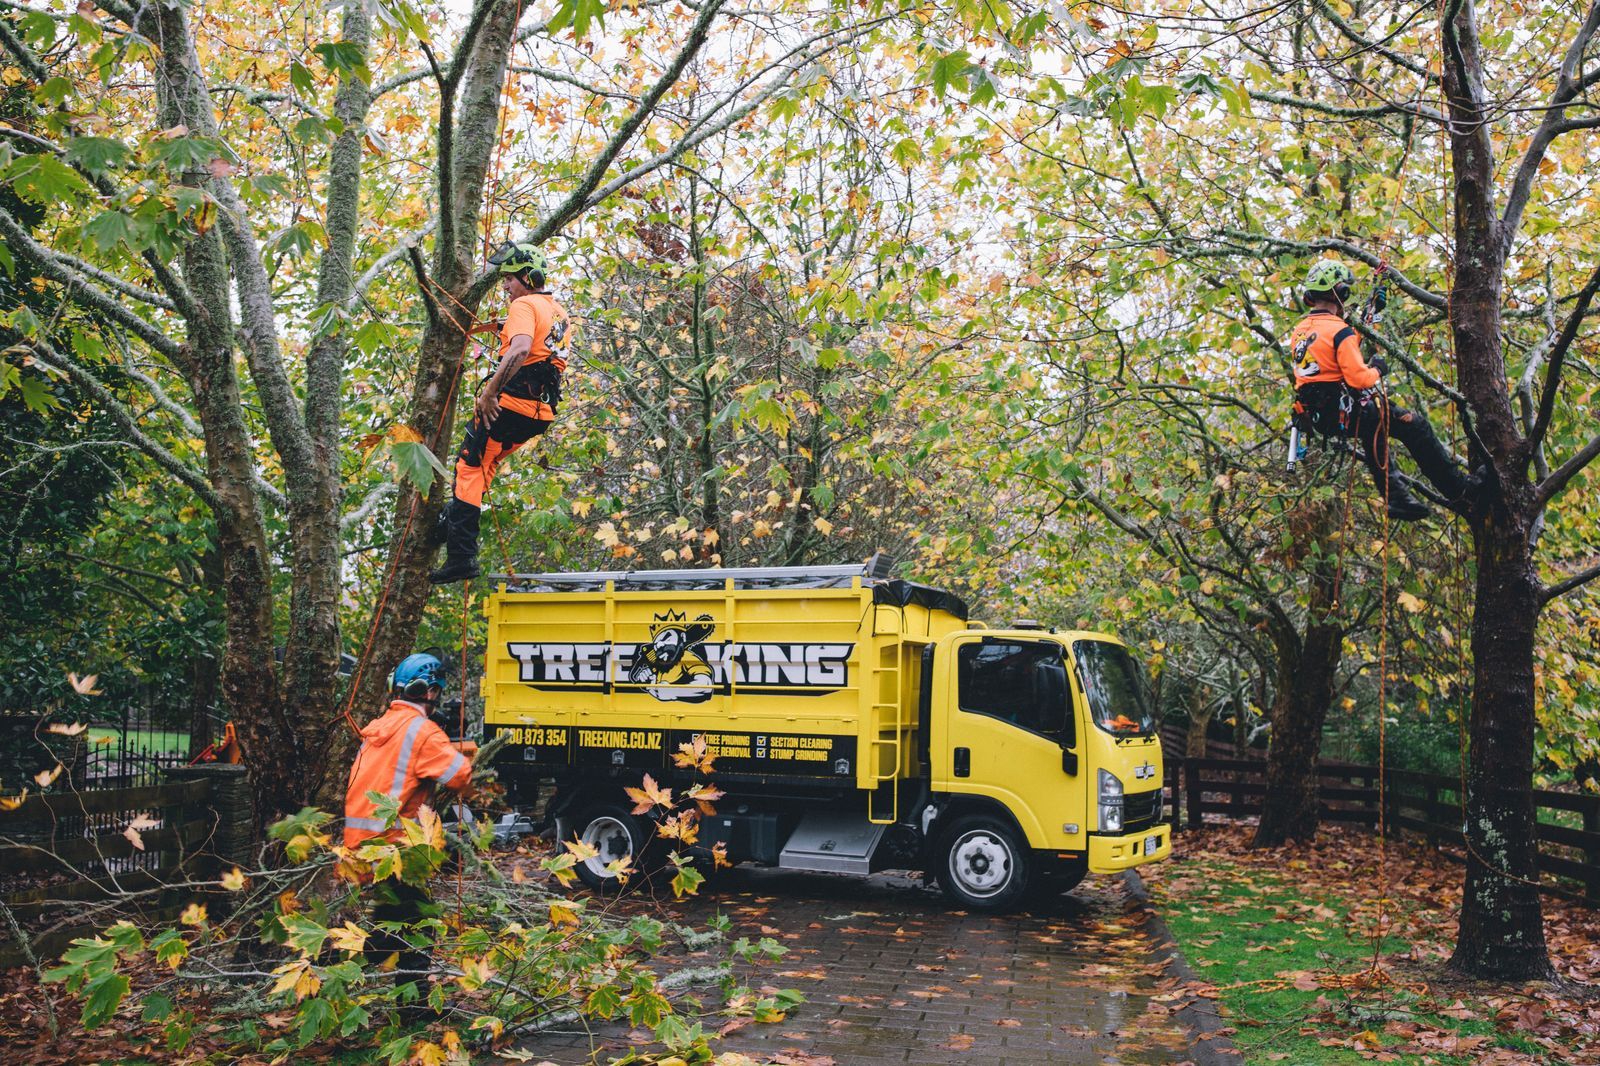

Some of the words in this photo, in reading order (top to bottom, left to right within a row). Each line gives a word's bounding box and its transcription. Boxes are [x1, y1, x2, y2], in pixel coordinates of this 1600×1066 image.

[508, 643, 637, 682] TREE
[704, 643, 851, 685] KING
[525, 728, 544, 745] 873
[546, 729, 567, 746] 354
[579, 730, 662, 749] TREEKING.CO.NZ
[705, 734, 720, 745] TREE
[721, 735, 750, 746] PRUNING
[770, 736, 799, 748] SECTION
[800, 737, 833, 750] CLEARING
[721, 746, 751, 758] REMOVAL
[769, 748, 794, 760] STUMP
[795, 749, 828, 762] GRINDING
